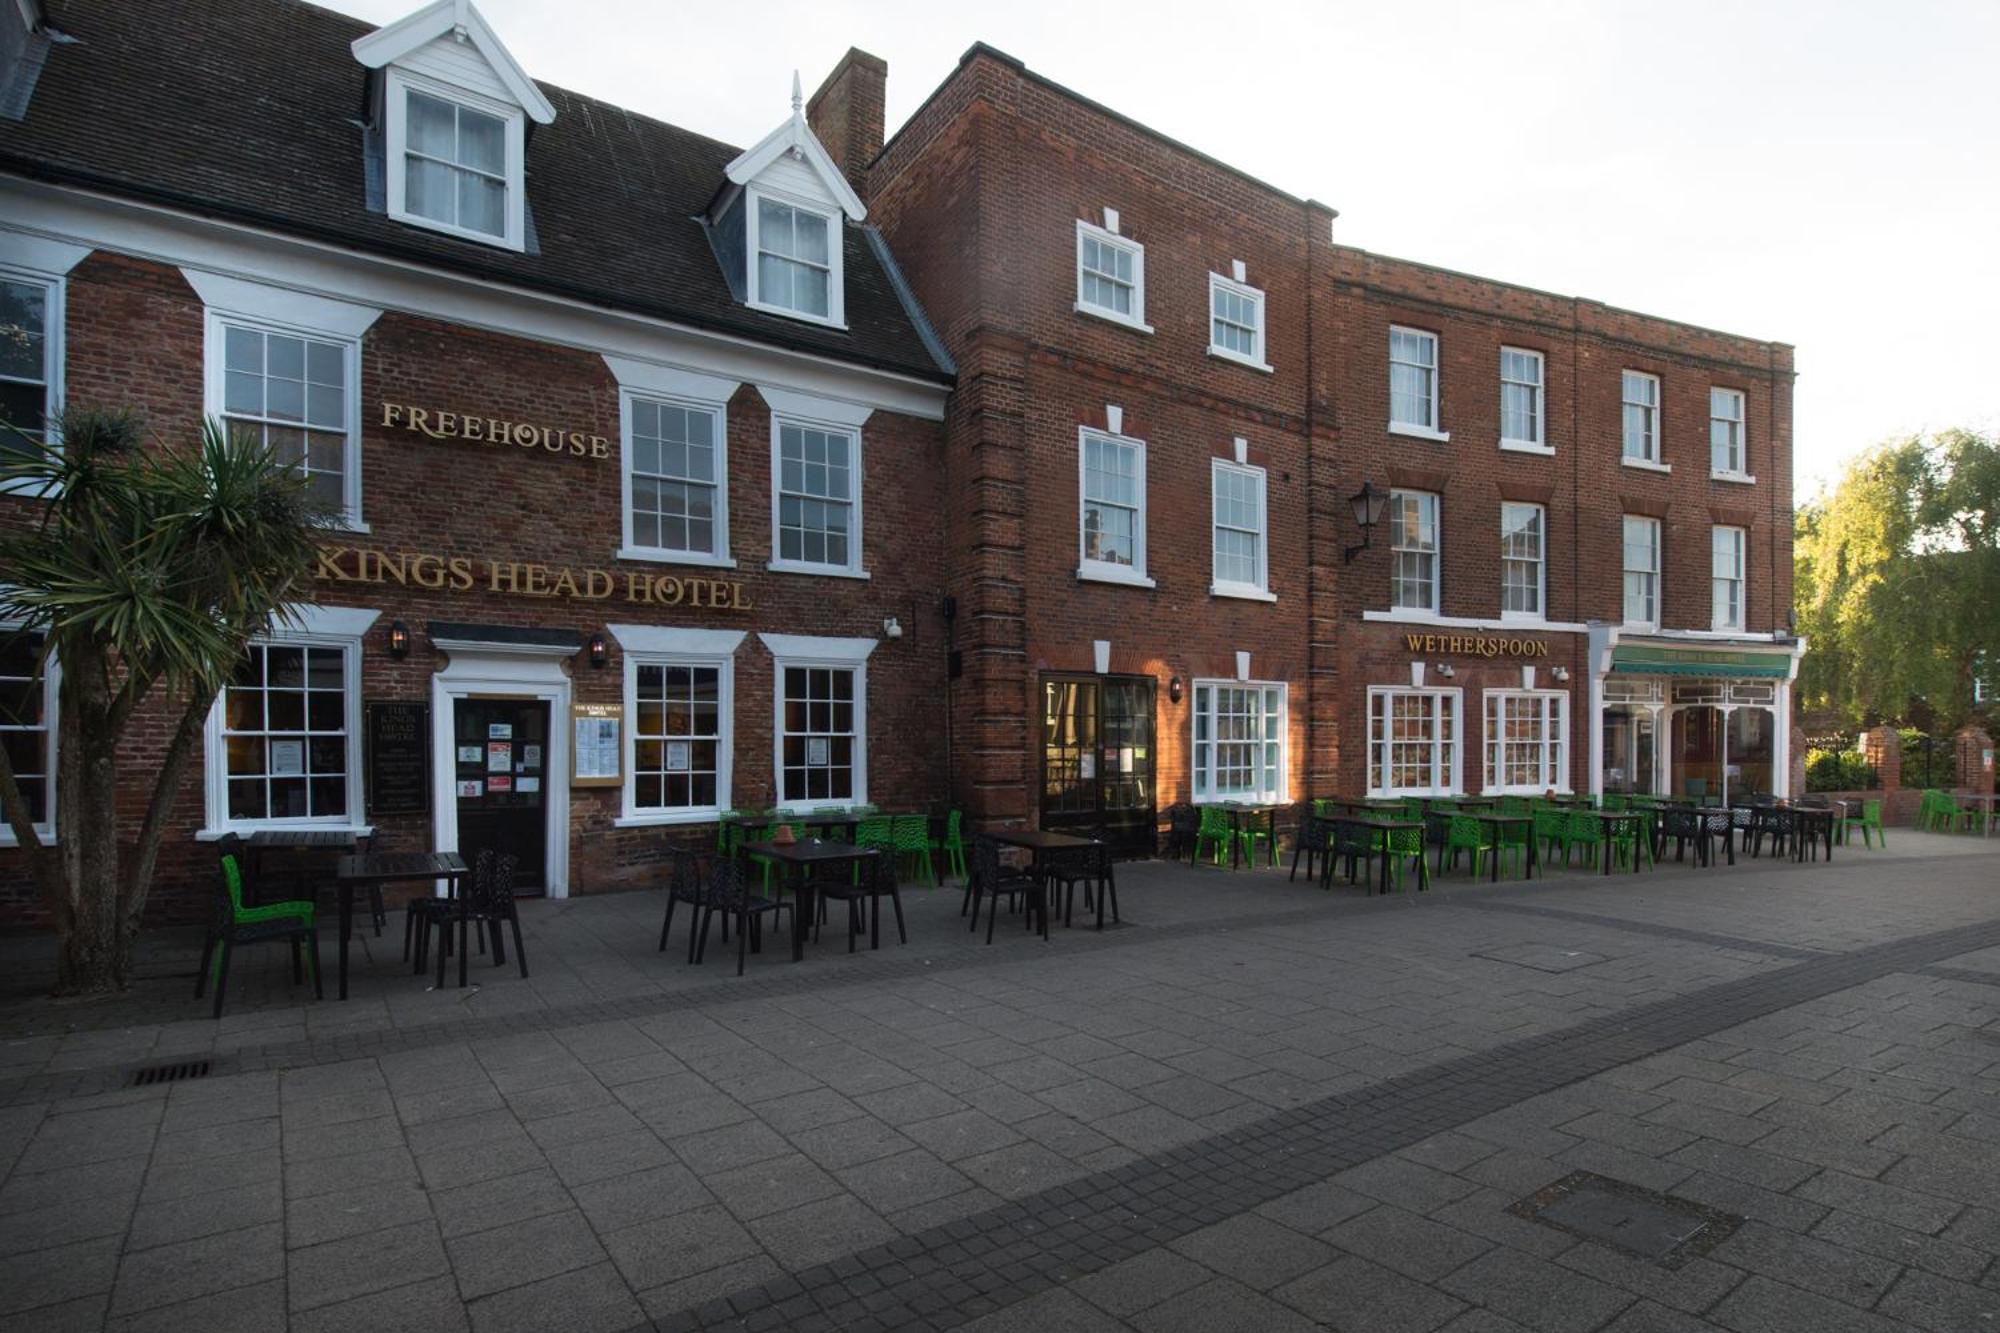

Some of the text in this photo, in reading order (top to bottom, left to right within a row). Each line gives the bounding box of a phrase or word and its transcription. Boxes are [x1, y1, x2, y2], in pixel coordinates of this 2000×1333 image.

[381, 402, 610, 459] FREEHOUSE
[313, 544, 753, 610] KINGS HEAD HOTEL
[1407, 634, 1548, 657] WETHERSPOON
